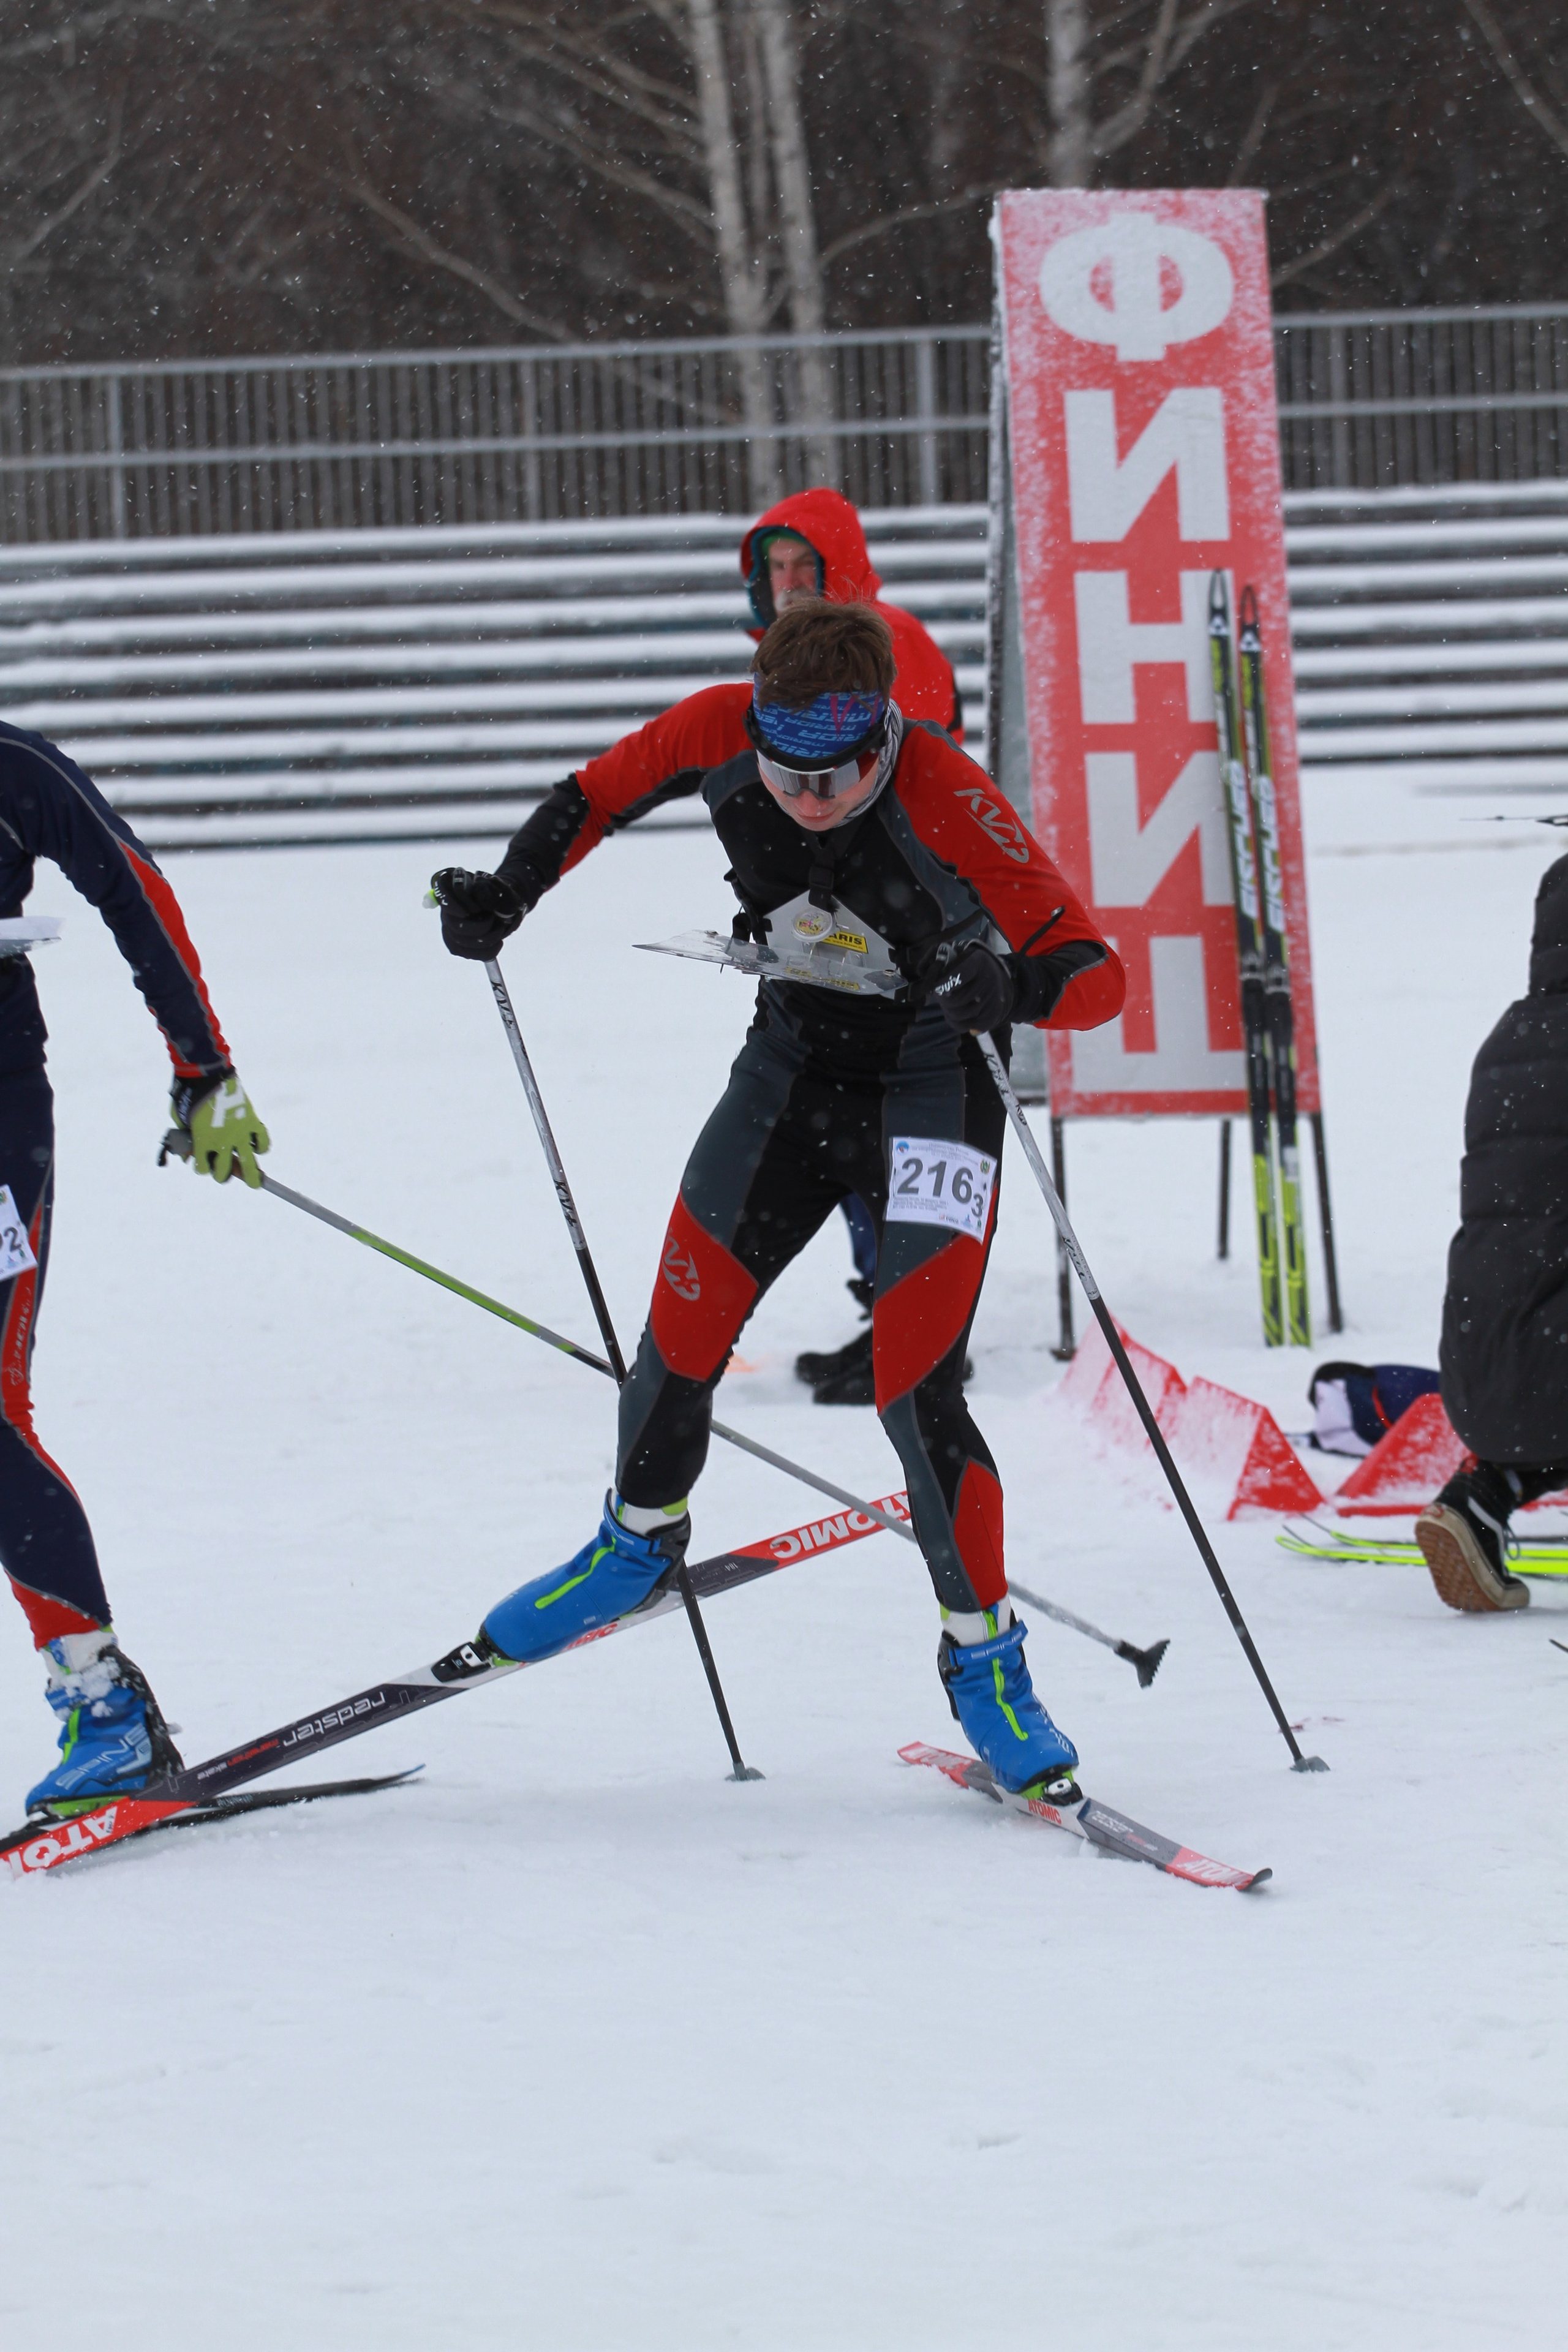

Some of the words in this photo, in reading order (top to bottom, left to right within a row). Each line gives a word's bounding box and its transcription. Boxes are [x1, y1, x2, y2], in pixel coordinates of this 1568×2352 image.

[897, 1158, 974, 1204] 216
[971, 1193, 984, 1217] 3
[282, 1691, 386, 1748] redster
[227, 1738, 279, 1767] marathon
[197, 1763, 228, 1780] skate
[1028, 1799, 1062, 1825] ATOMIC
